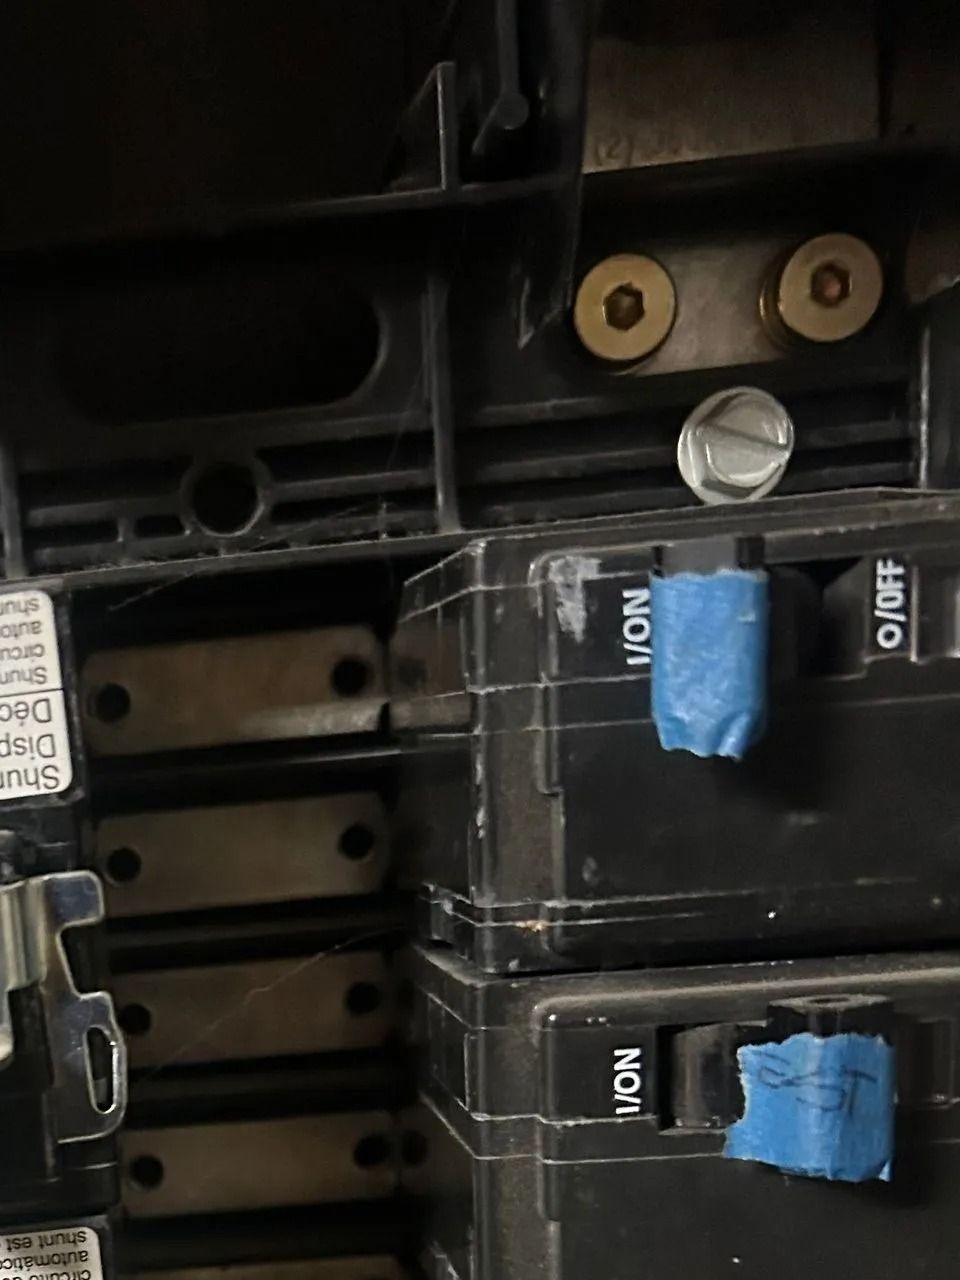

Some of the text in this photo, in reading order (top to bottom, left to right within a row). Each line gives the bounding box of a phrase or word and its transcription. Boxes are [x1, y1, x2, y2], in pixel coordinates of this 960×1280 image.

[622, 587, 651, 667] I/ON
[874, 559, 907, 648] O/OFF
[614, 1047, 642, 1114] I/ON
[5, 1236, 33, 1252] est
[37, 1230, 88, 1249] shunt
